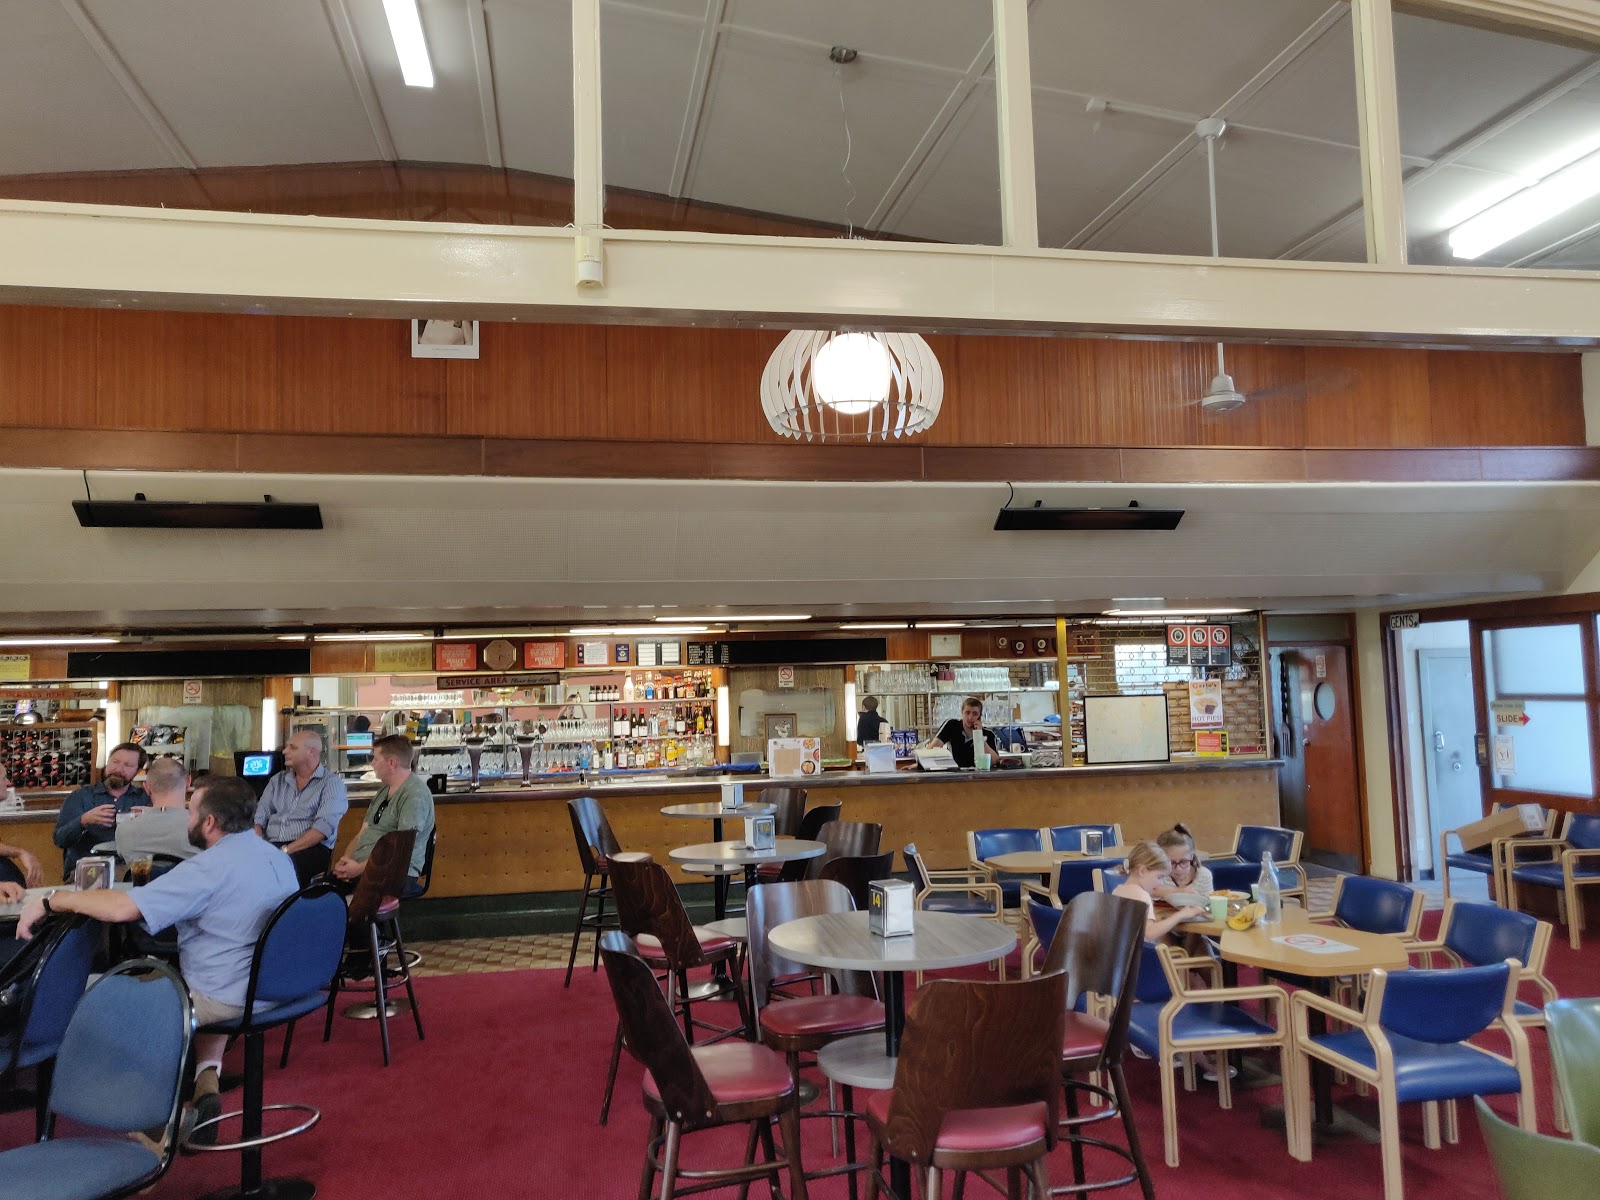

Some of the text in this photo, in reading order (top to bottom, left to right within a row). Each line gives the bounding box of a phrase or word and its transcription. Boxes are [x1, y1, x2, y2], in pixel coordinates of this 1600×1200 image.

[1390, 614, 1414, 629] GENTS
[445, 678, 478, 687] SERVICE
[484, 676, 508, 685] AREA
[1496, 714, 1518, 723] SLIDE
[87, 866, 97, 878] 4
[872, 891, 881, 908] 14
